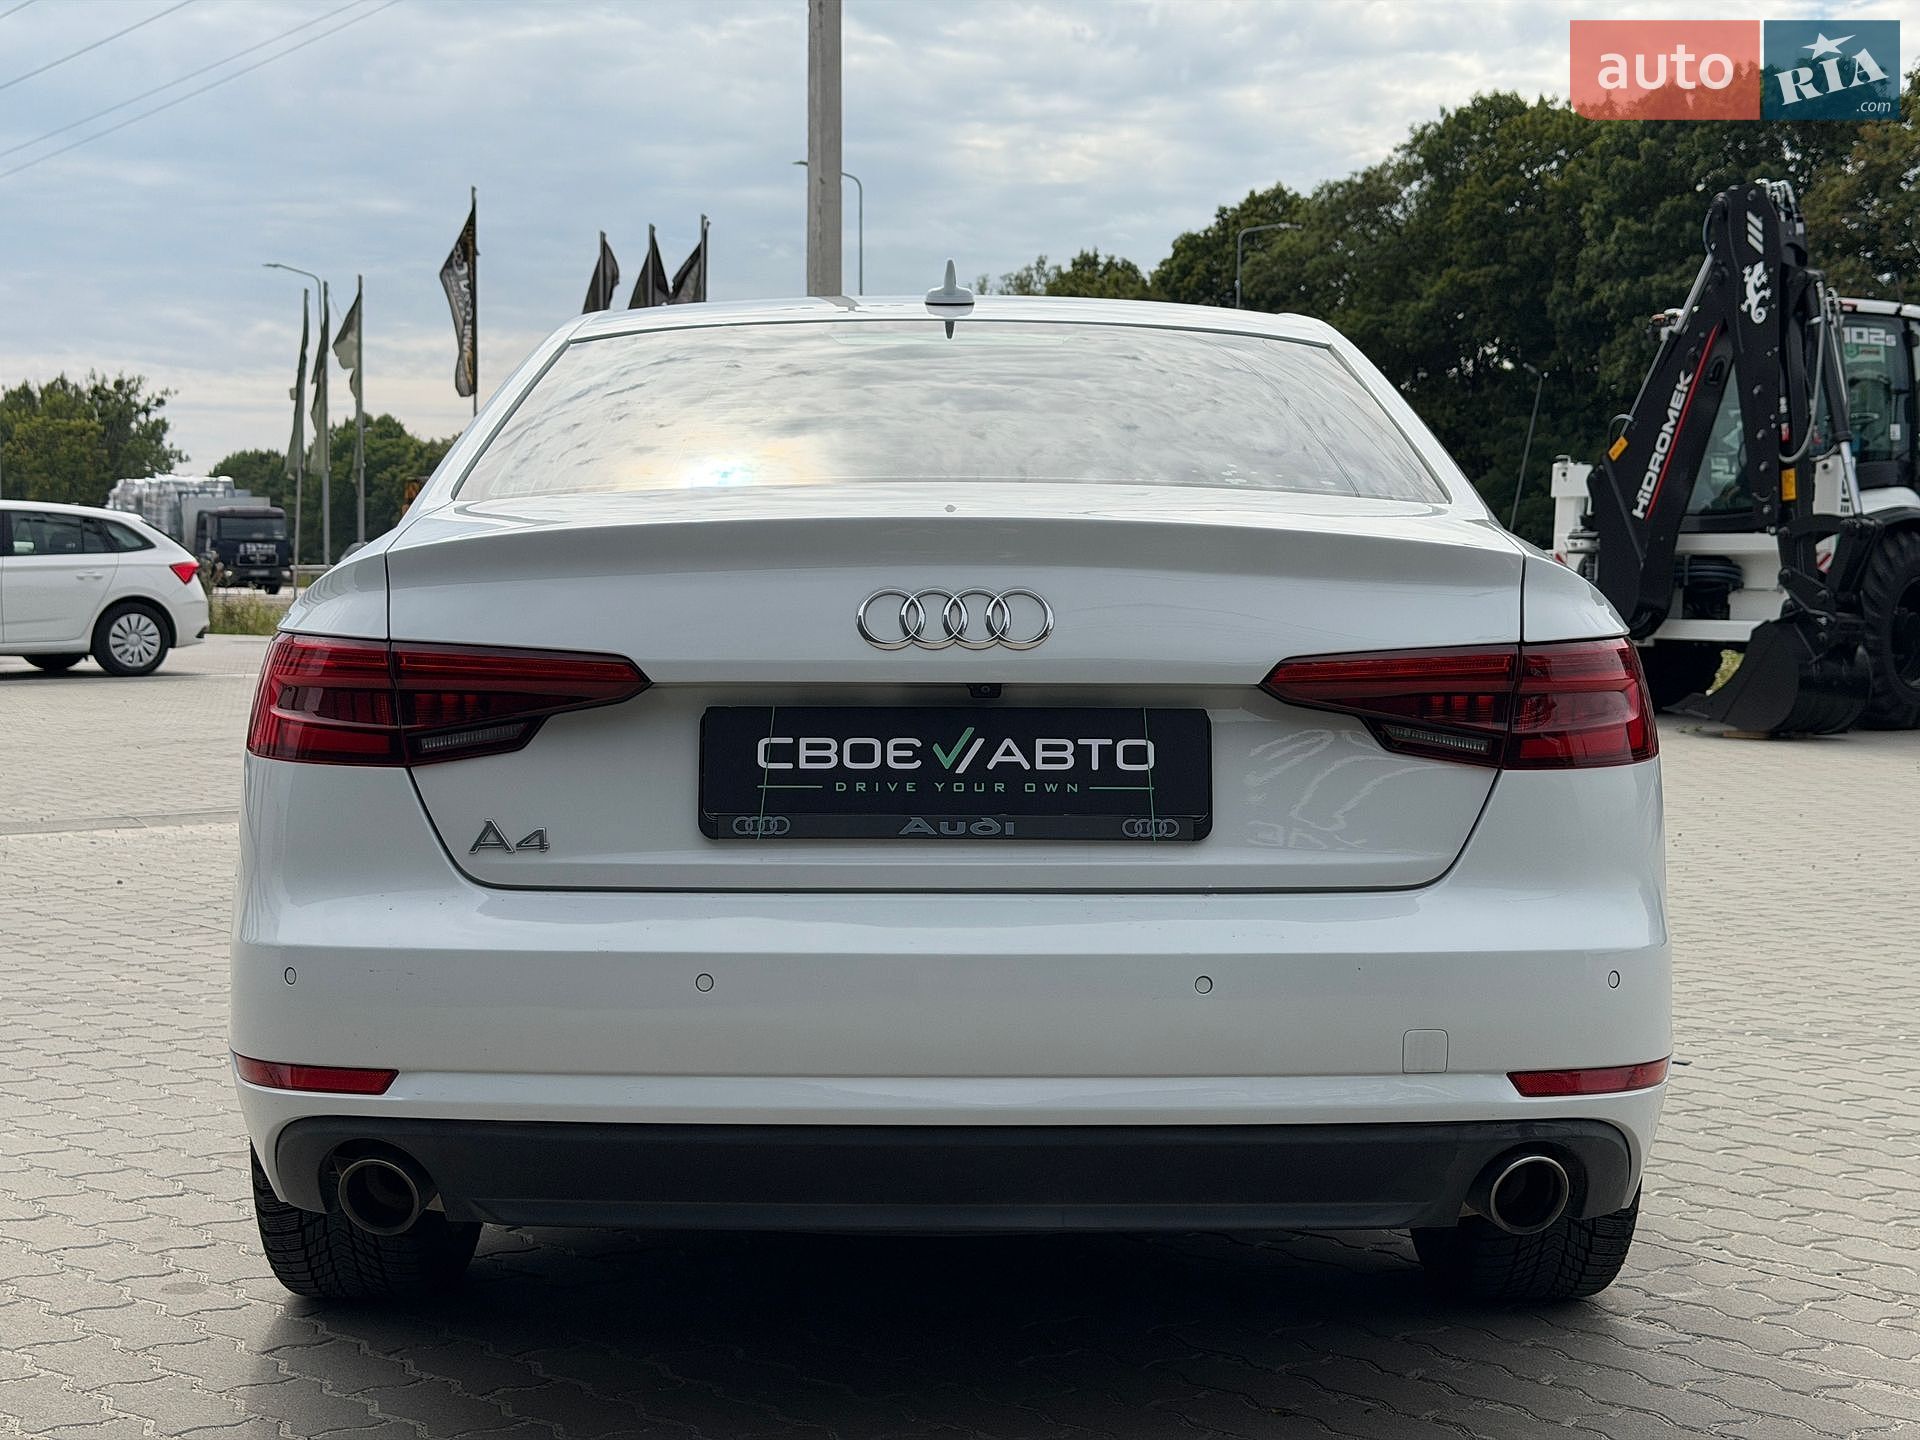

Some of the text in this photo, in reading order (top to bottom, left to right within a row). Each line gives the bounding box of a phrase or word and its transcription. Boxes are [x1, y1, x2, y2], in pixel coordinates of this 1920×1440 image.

[835, 782, 1079, 793] DRIVE YOUR OWN
[468, 817, 551, 854] A4
[899, 816, 1016, 837] Audi
